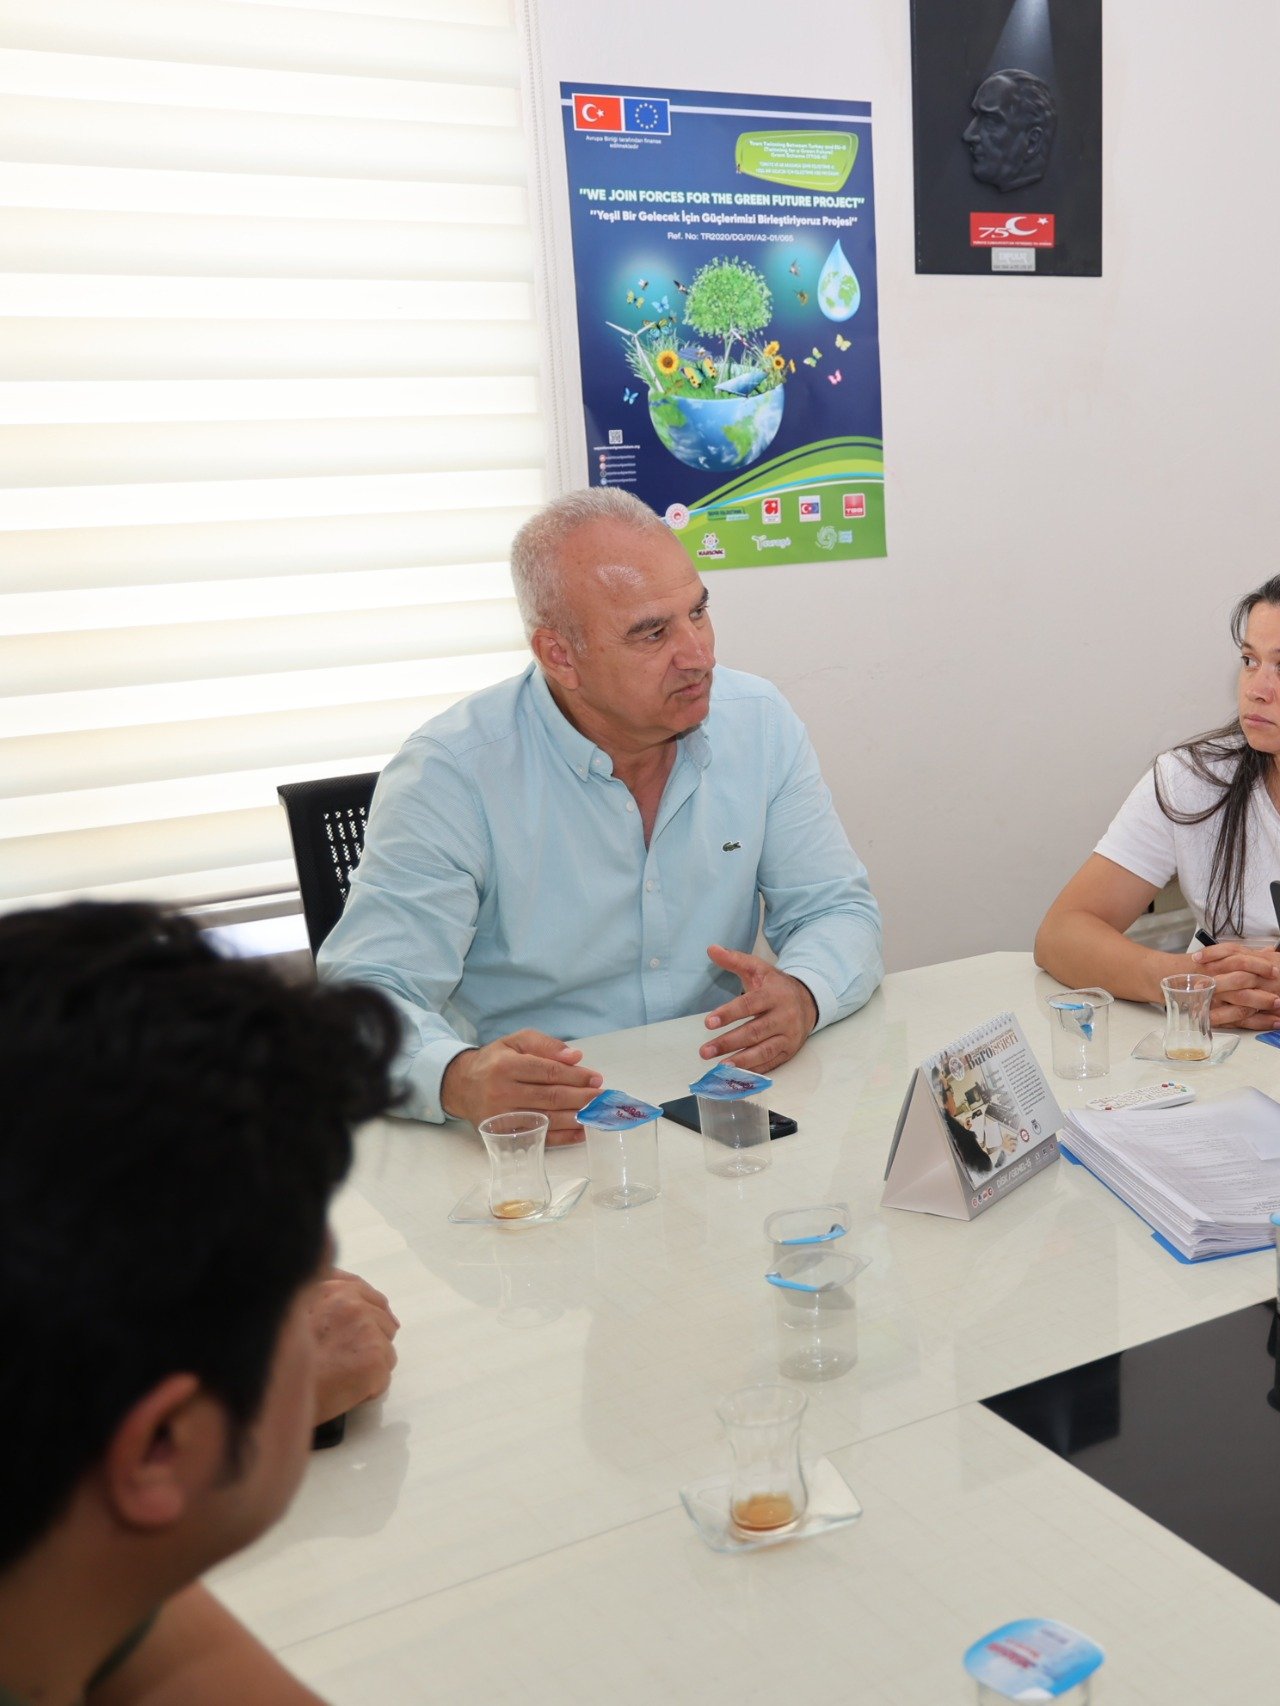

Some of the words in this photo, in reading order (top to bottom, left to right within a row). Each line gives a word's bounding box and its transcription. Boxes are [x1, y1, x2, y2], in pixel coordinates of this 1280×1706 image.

[608, 189, 637, 202] JOIN
[639, 190, 684, 203] FORCES
[686, 191, 710, 204] FOR
[711, 192, 732, 205] THE
[734, 193, 771, 206] GREEN
[772, 194, 812, 207] FUTURE
[622, 210, 637, 221] Bir
[638, 211, 680, 223] Gelecek
[681, 210, 700, 225] İçin
[701, 212, 756, 225] Güçlerimizi
[757, 213, 820, 227] Birleştiriyoruz
[667, 232, 683, 240] Ref.
[685, 232, 699, 240] No:
